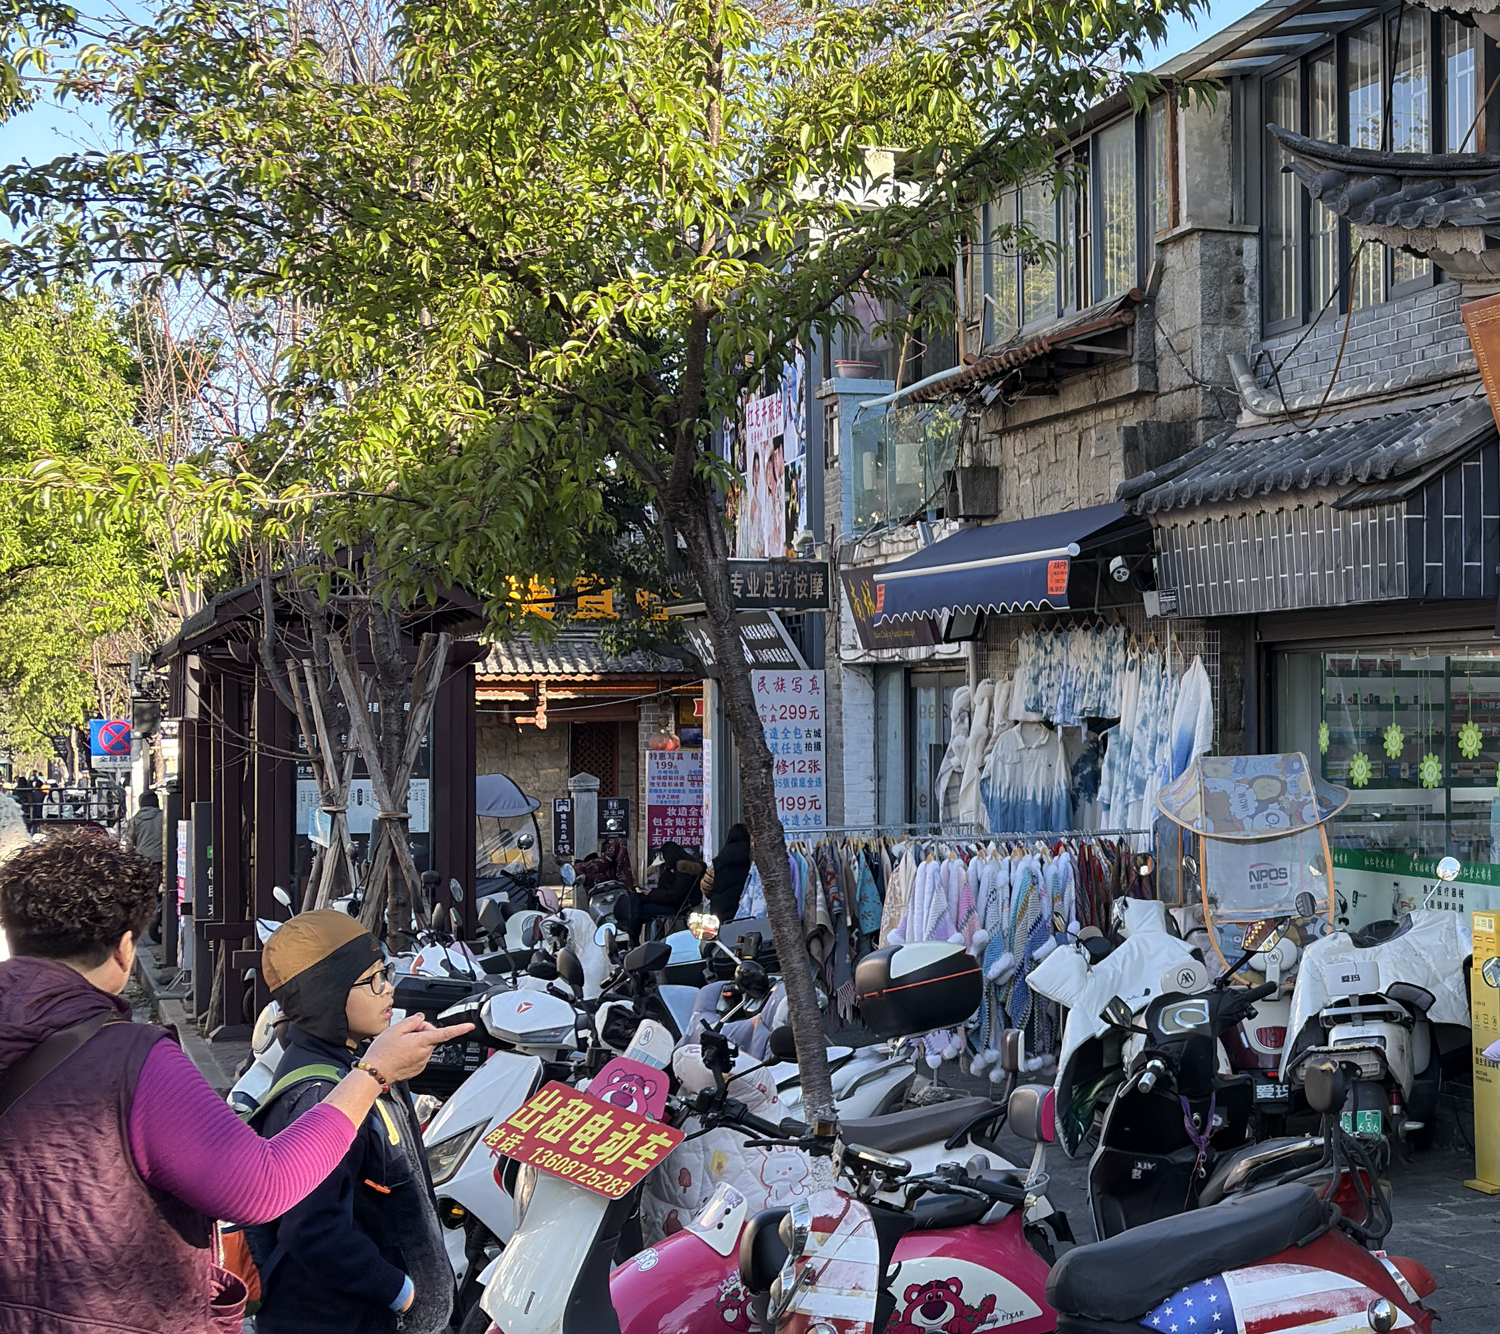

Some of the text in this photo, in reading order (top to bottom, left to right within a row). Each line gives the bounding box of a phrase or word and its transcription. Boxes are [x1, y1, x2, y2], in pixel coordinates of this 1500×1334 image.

[729, 570, 825, 600] 专业足疗按摩
[757, 674, 821, 696] 民族写真
[778, 704, 820, 721] 299元
[1248, 867, 1288, 883] NPOS
[507, 1088, 674, 1177] 出租电动车
[1344, 1121, 1379, 1133] 5636
[528, 1146, 632, 1197] 13608725283
[1001, 1310, 1025, 1322] PIXAR
